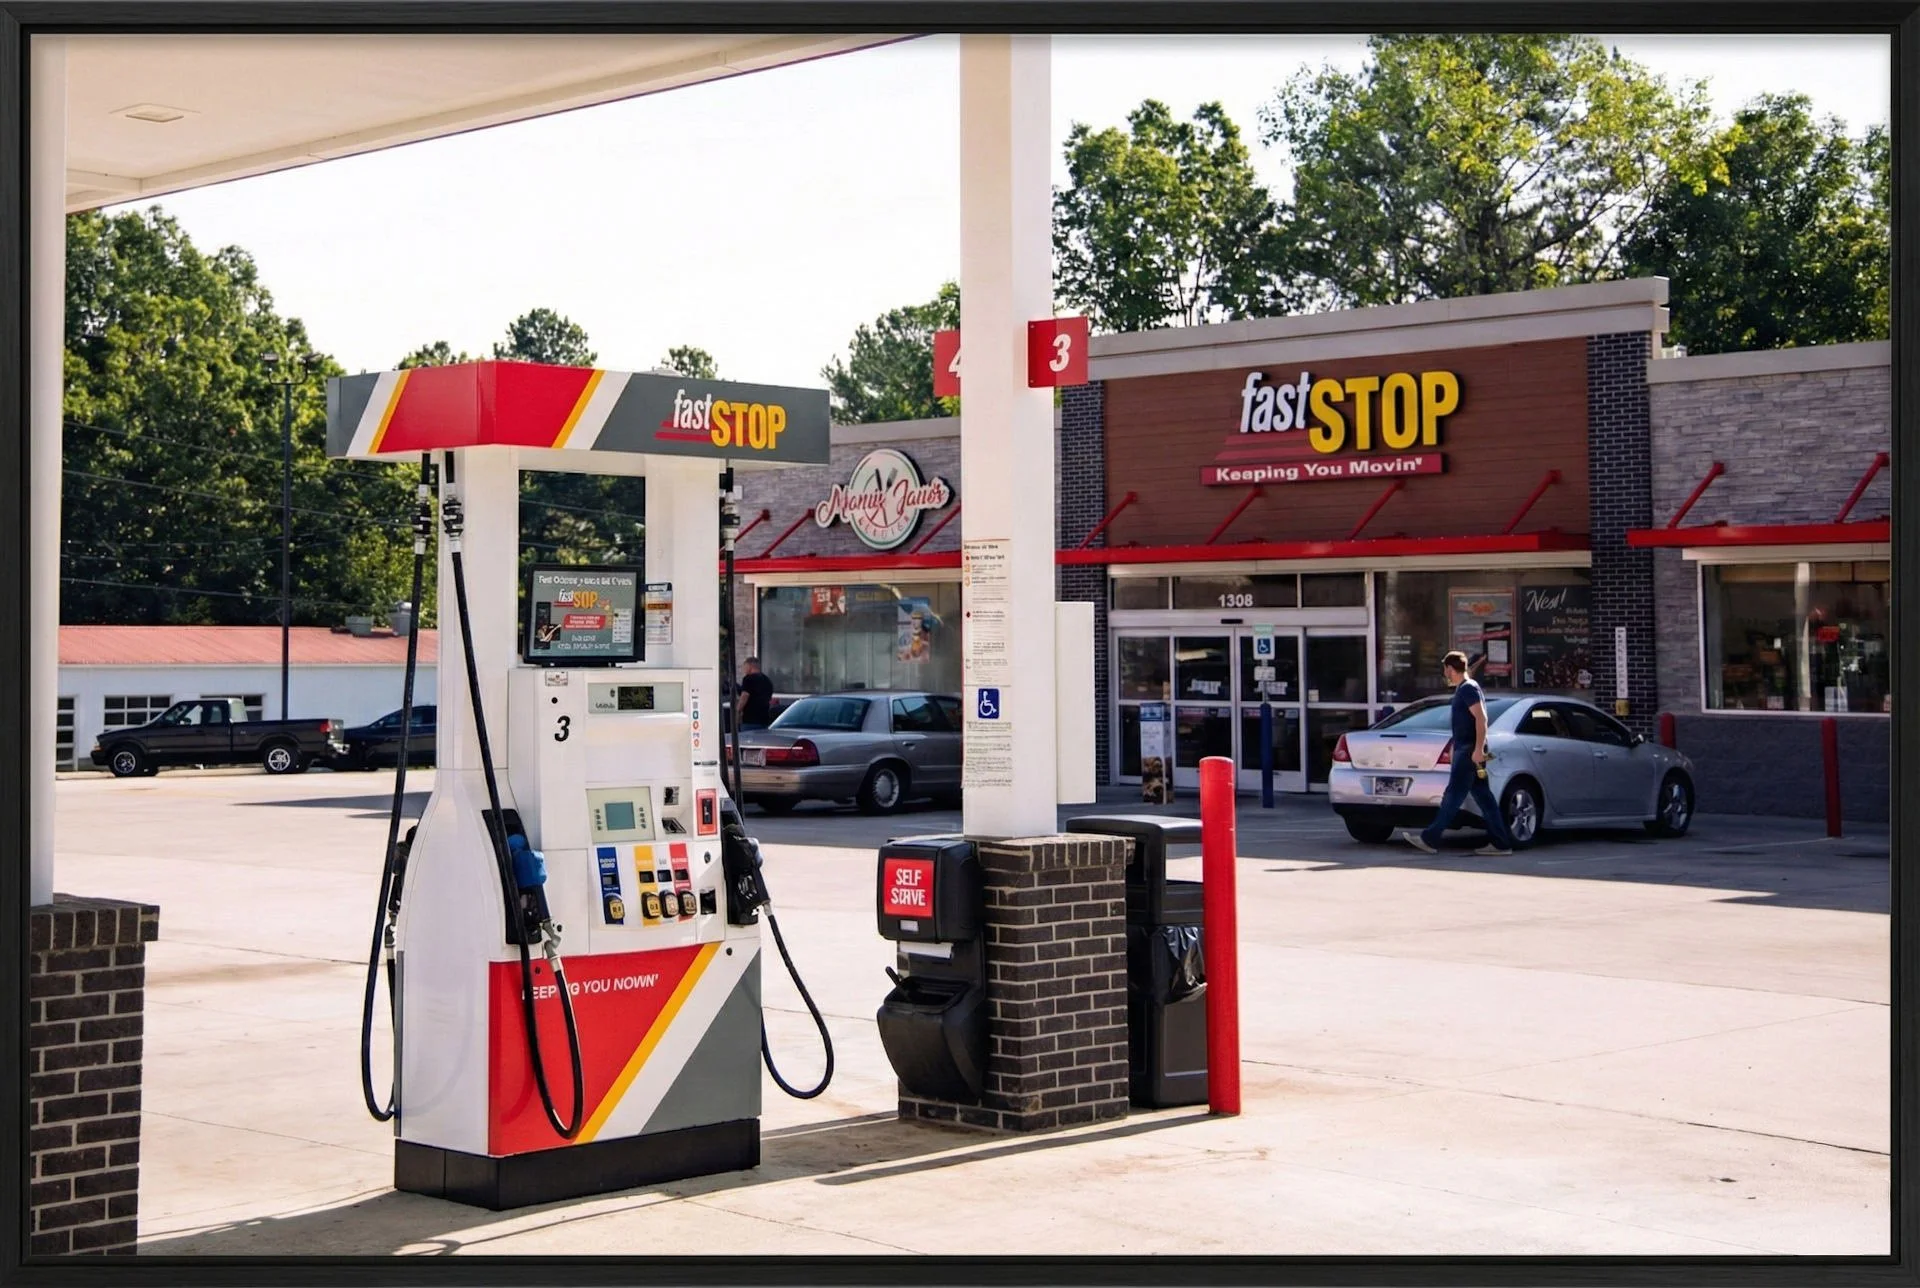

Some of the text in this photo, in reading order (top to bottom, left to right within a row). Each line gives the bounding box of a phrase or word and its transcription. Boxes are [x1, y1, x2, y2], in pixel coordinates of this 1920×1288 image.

[1049, 333, 1072, 372] 3
[1216, 457, 1423, 483] Keeping You Movin'
[1218, 594, 1253, 607] 1308
[554, 715, 571, 742] 3
[896, 868, 922, 886] SELF
[583, 978, 610, 994] YOU
